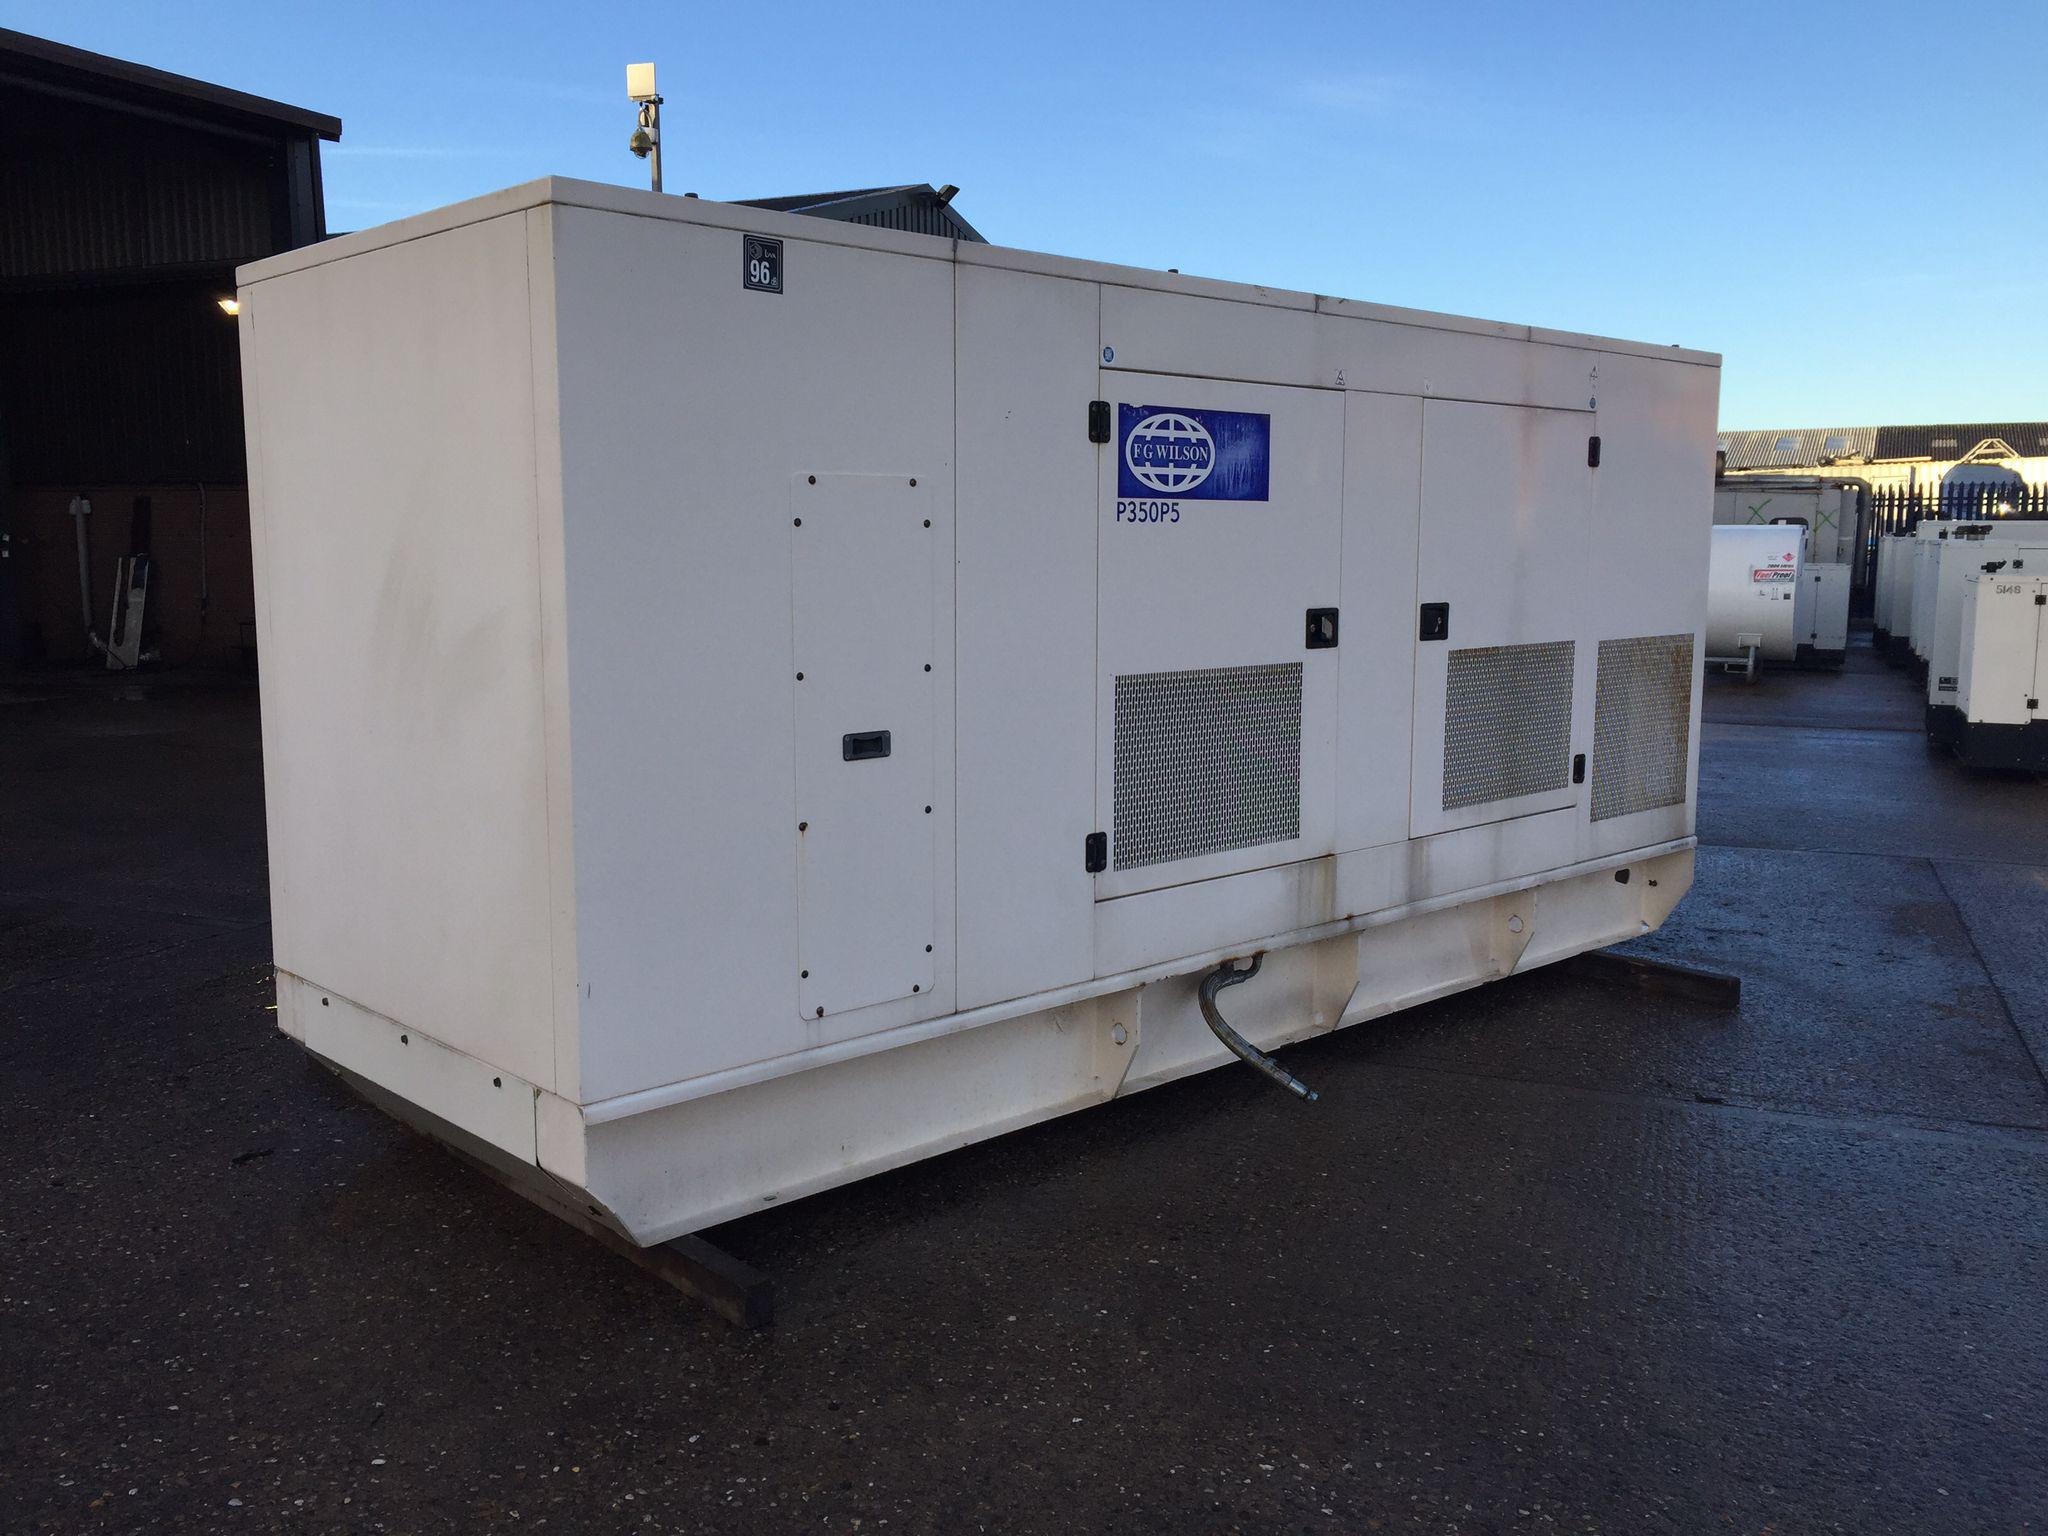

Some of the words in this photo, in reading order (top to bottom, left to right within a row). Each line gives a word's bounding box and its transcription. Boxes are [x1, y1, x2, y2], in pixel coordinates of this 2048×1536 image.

[750, 259, 770, 284] 96
[1133, 443, 1154, 460] FG
[1155, 444, 1209, 462] WILSON
[1116, 500, 1180, 523] P350P5
